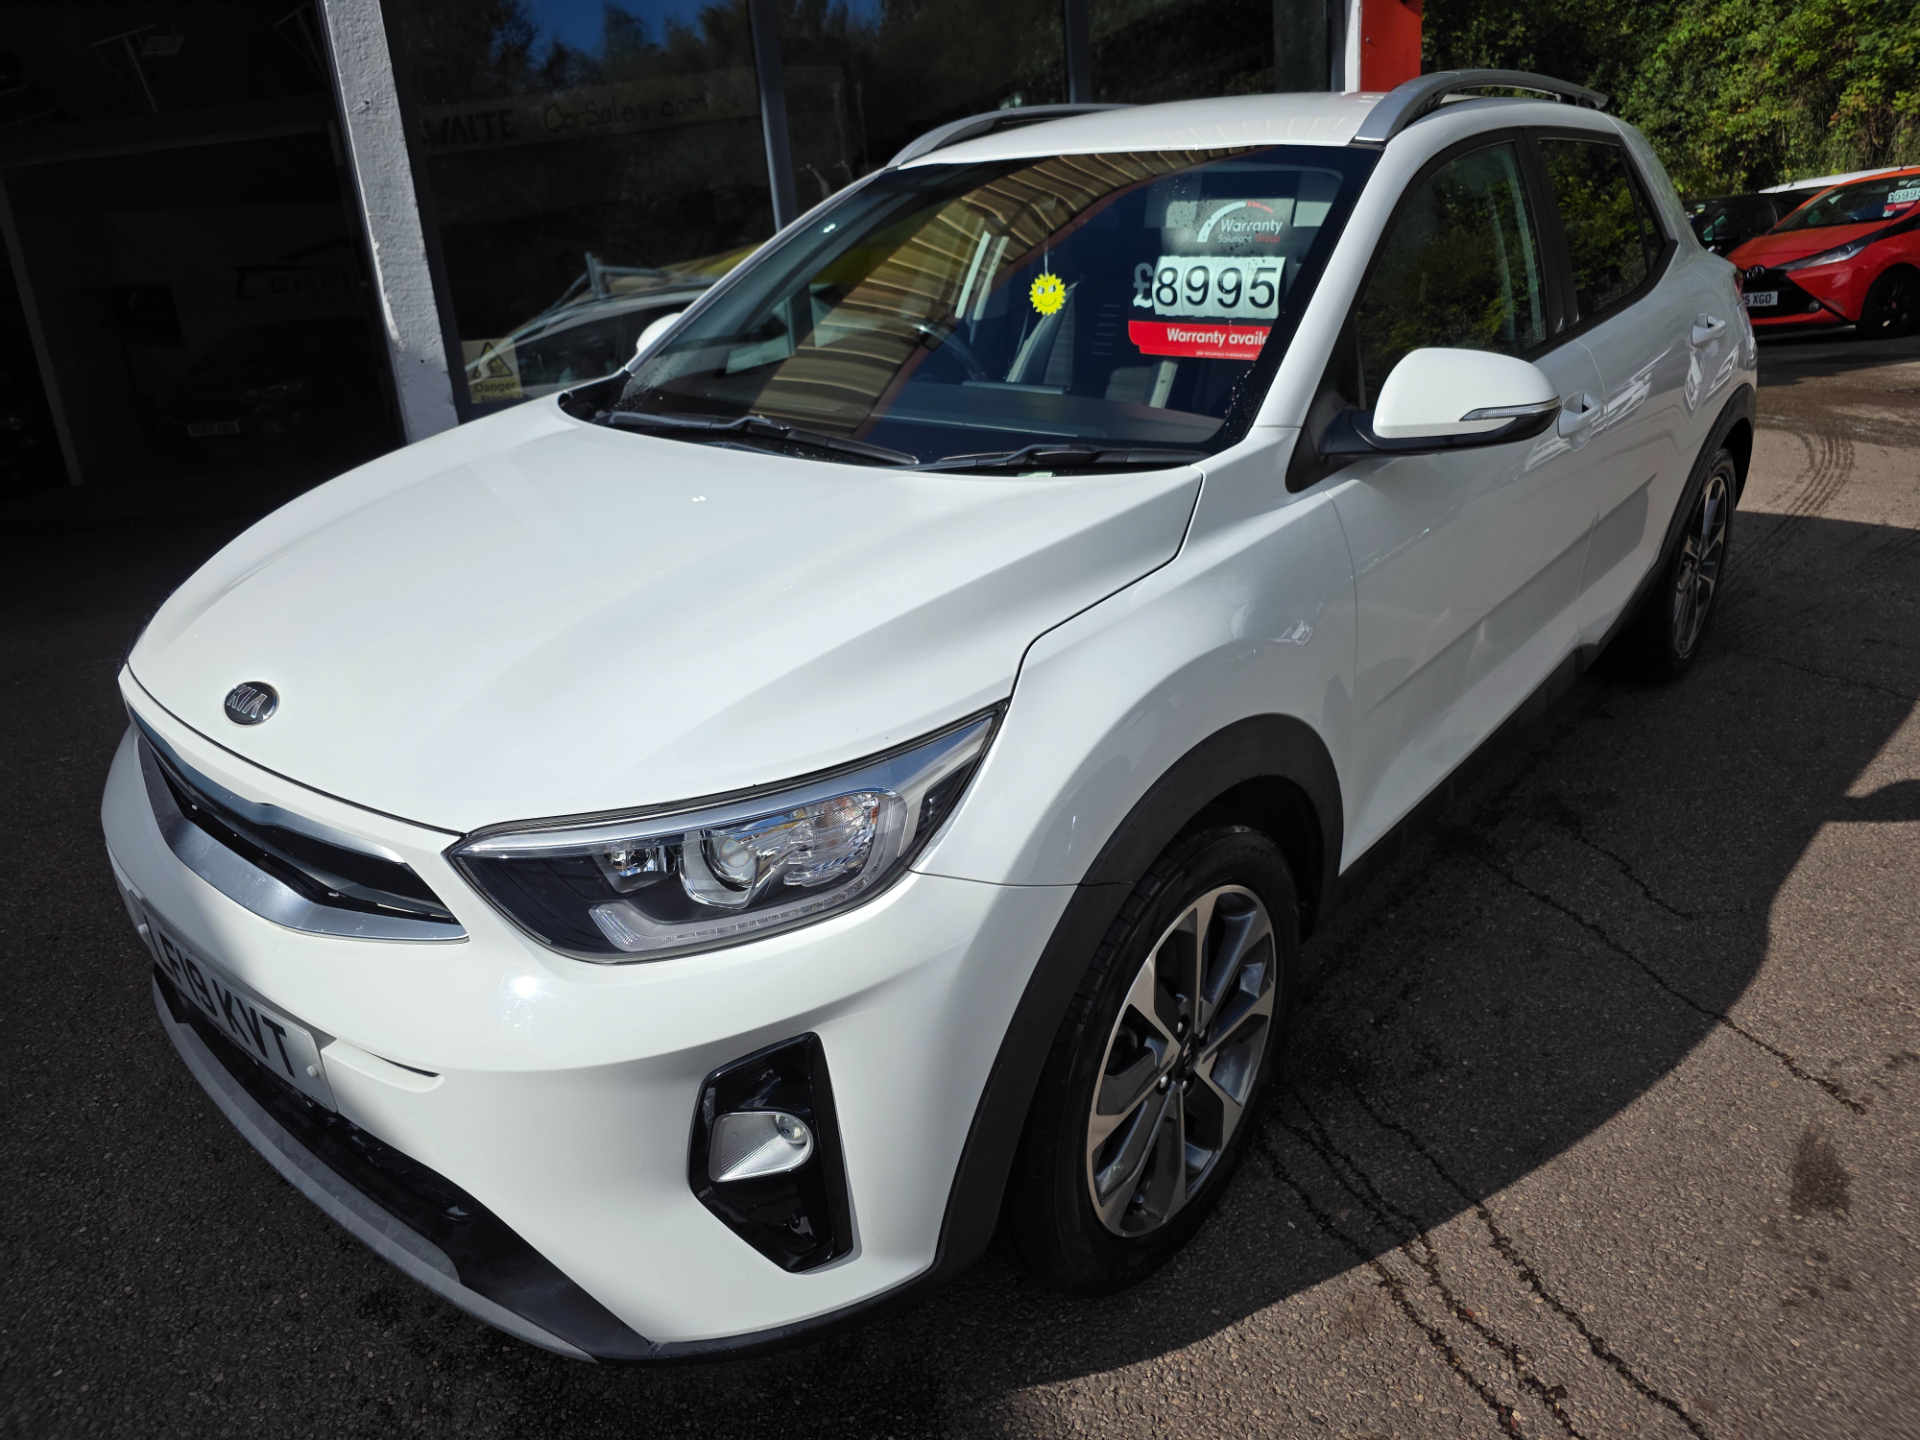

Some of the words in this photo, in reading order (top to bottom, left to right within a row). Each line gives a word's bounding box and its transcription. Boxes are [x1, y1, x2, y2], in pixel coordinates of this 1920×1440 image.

[1220, 219, 1283, 236] Warranty
[1218, 234, 1252, 243] Solutions
[1254, 234, 1281, 244] Group
[1753, 293, 1771, 304] XGO
[1166, 327, 1226, 348] Warranty
[474, 382, 515, 394] Danger
[226, 683, 268, 719] KIA
[143, 912, 219, 1018] LF19
[211, 978, 296, 1079] KVT
